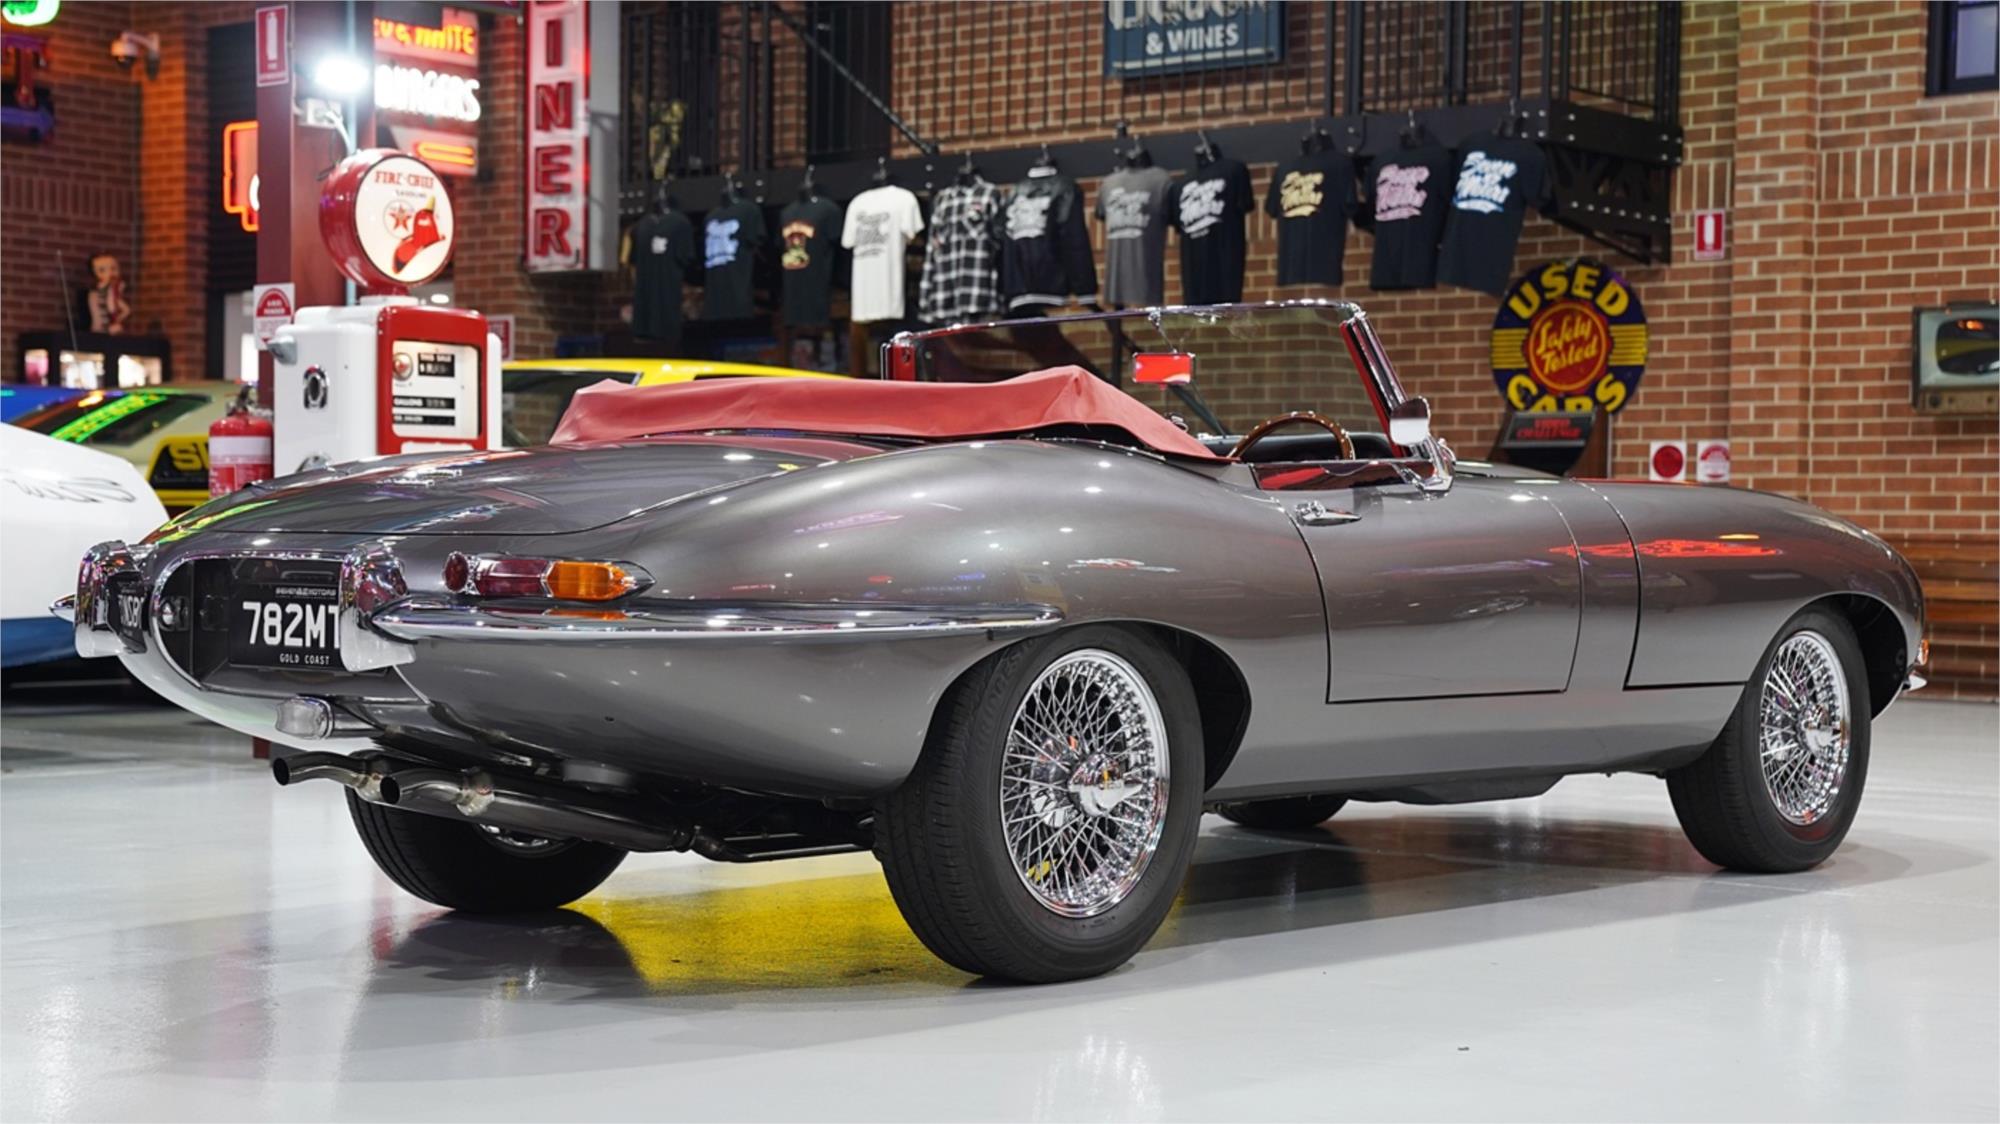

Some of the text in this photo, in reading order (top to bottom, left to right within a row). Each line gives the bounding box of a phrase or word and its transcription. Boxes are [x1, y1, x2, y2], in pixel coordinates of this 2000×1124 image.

[1146, 22, 1240, 55] & WINES
[532, 1, 576, 257] INER
[1508, 264, 1629, 319] USED
[1536, 314, 1593, 356] Safety
[1541, 334, 1598, 375] Tested
[1507, 373, 1627, 412] CARS
[280, 652, 330, 665] GOLD COAST
